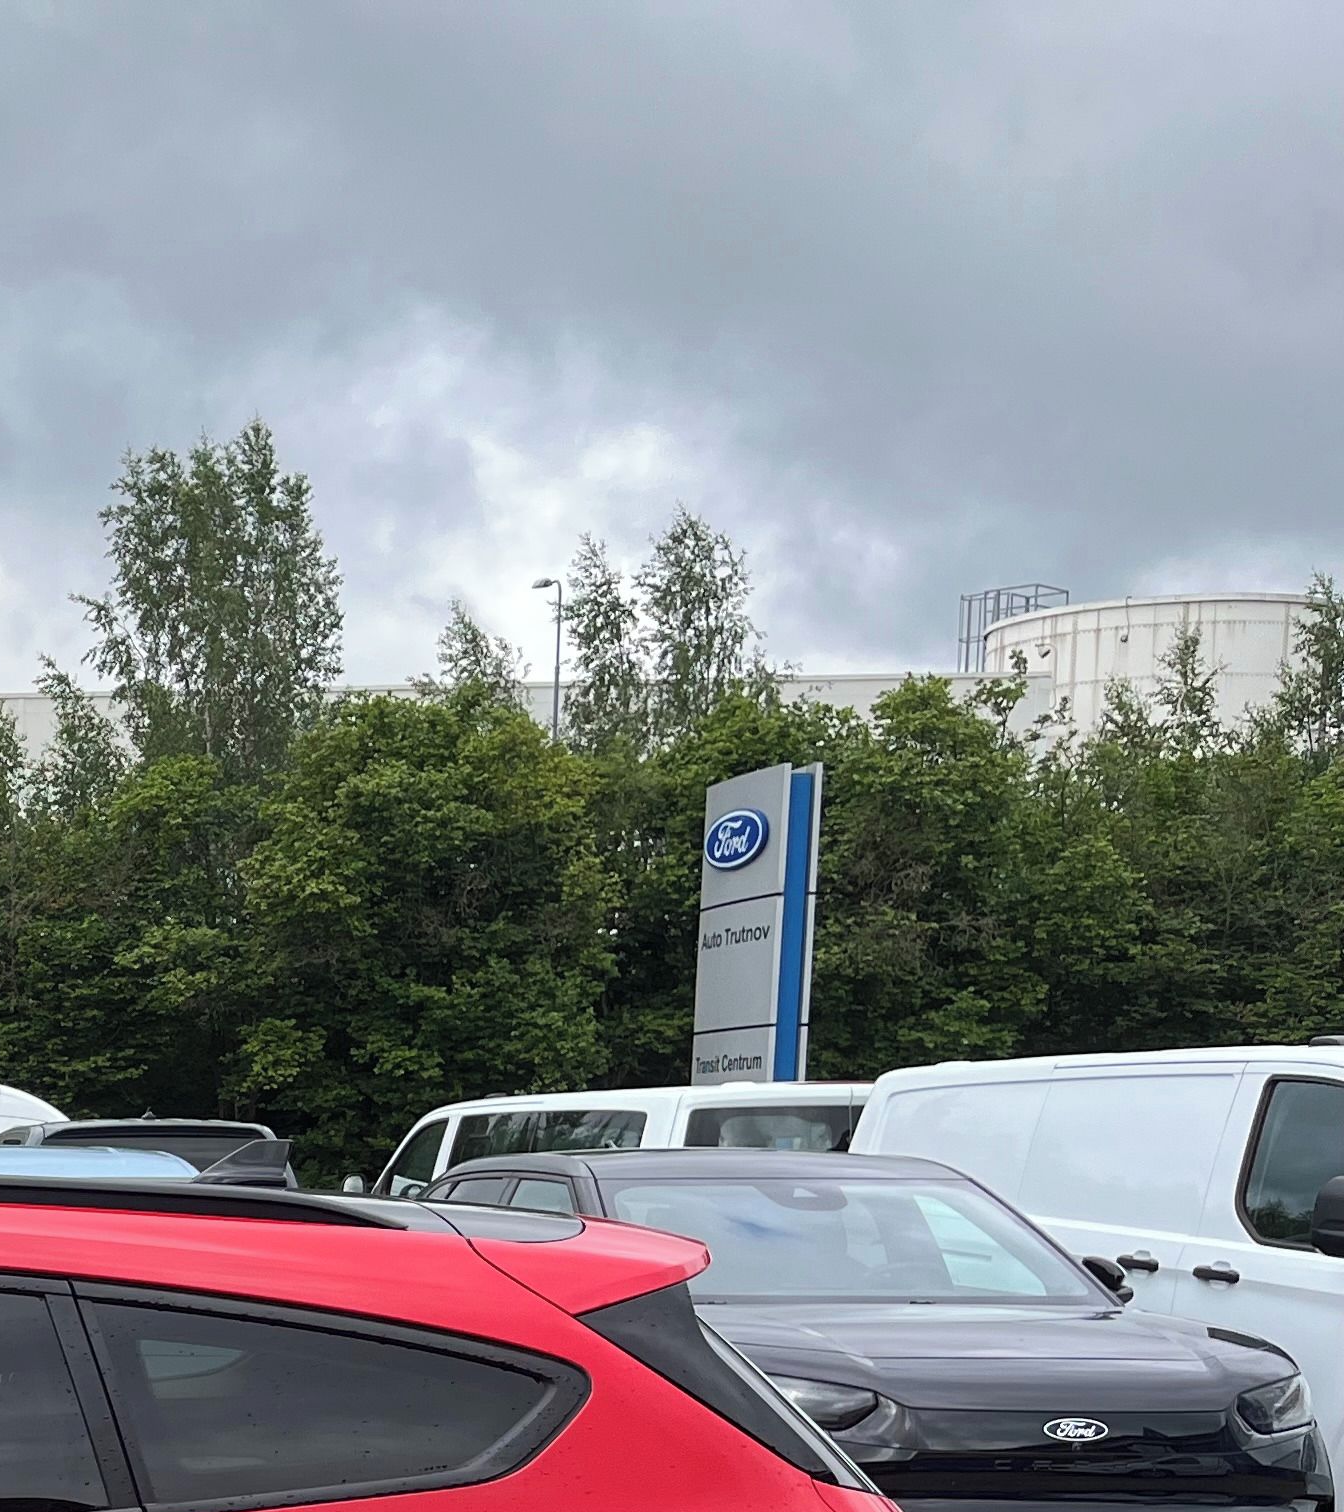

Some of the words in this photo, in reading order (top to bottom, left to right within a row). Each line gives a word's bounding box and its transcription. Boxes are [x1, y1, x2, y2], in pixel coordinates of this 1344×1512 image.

[714, 819, 750, 858] Ford
[701, 932, 722, 950] Auto
[725, 925, 771, 946] Trutnov
[695, 1055, 720, 1074] Transit
[721, 1053, 762, 1073] Centrum
[1056, 1420, 1096, 1438] Ford
